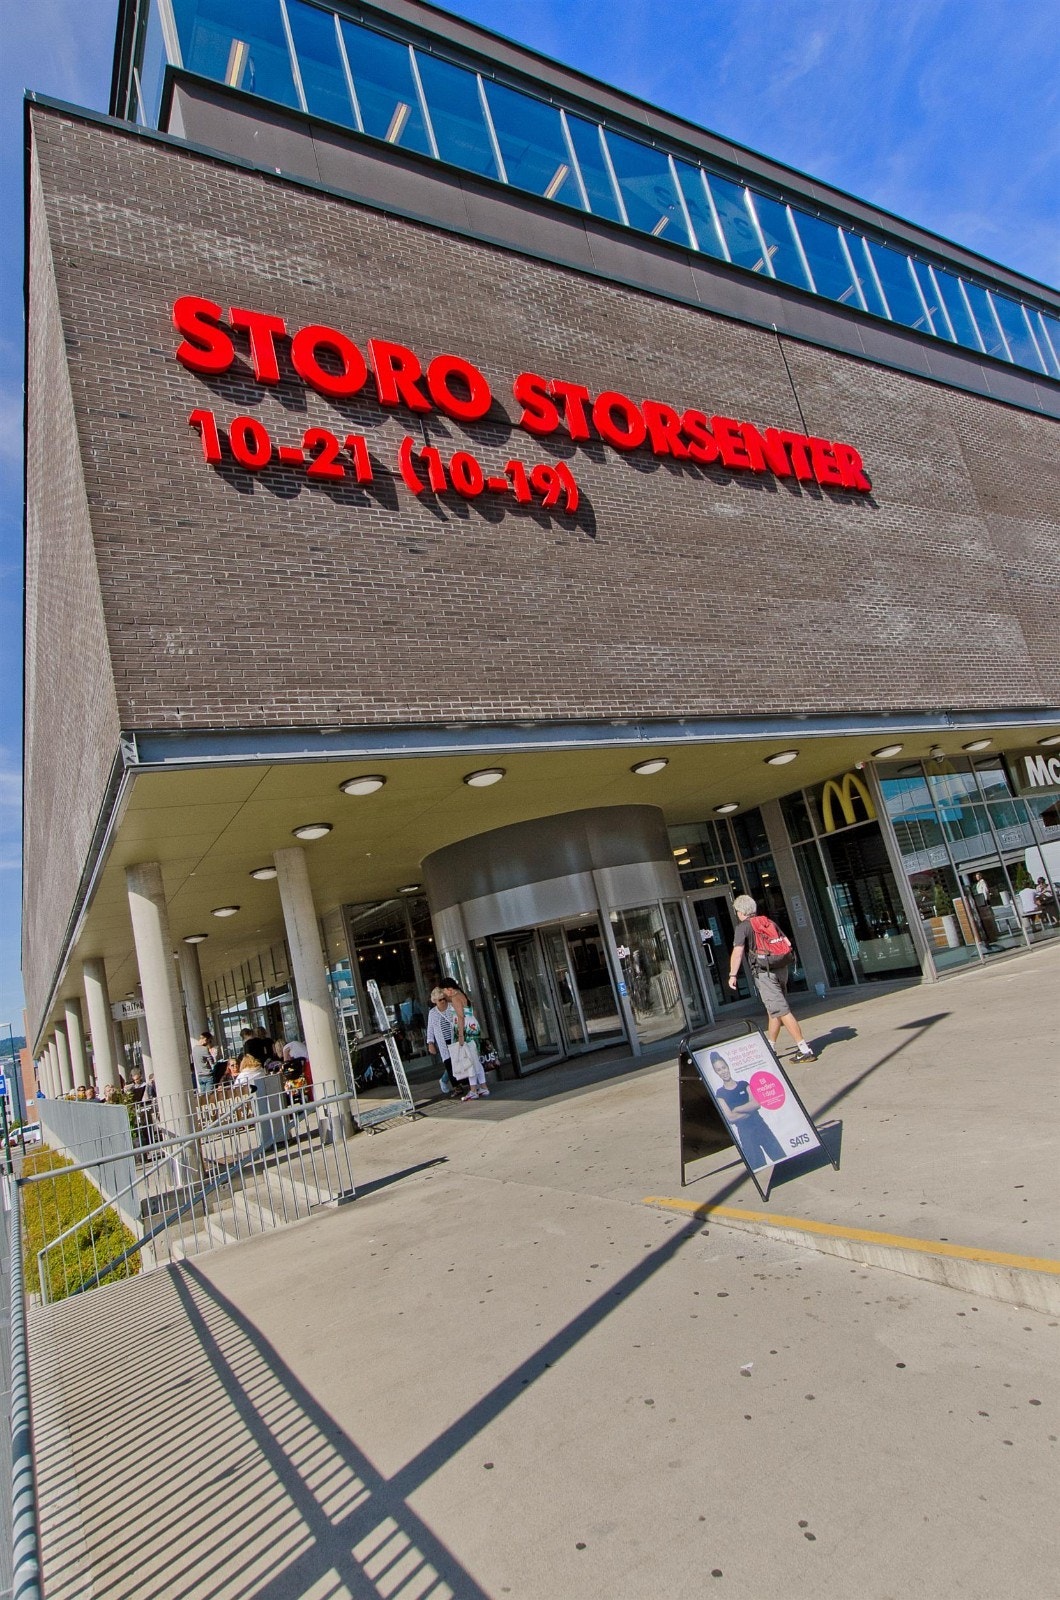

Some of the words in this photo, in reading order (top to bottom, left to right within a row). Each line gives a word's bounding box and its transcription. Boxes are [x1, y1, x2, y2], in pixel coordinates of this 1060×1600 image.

[173, 295, 492, 422] STORO
[513, 372, 873, 493] STORSENTER
[189, 409, 373, 484] 10-21
[399, 436, 579, 515] (10-19)
[789, 1133, 810, 1148] SATS
